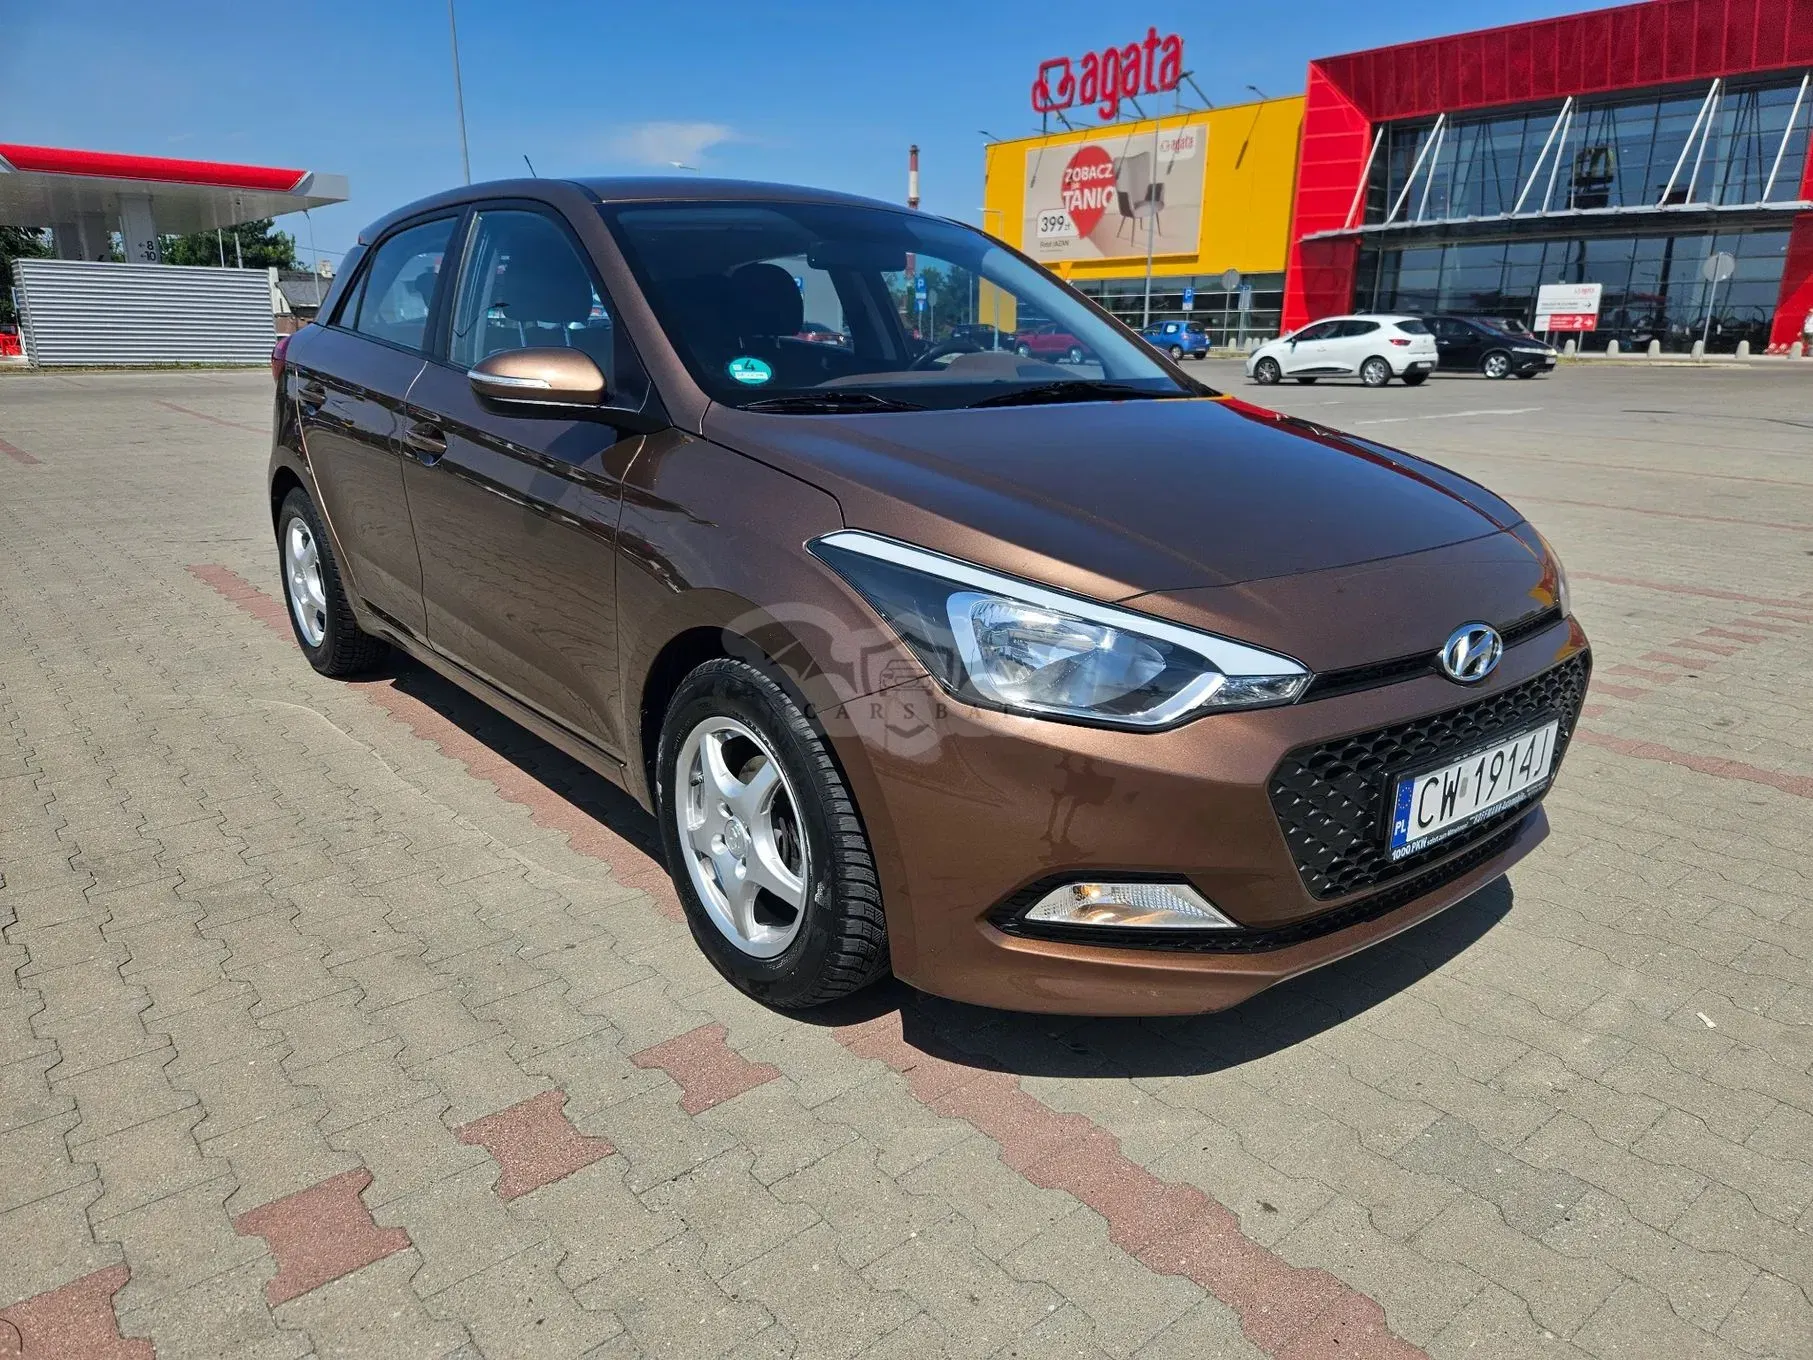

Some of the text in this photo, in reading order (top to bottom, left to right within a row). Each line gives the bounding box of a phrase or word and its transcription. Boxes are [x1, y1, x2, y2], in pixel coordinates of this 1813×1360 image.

[1079, 26, 1184, 120] agata
[1065, 163, 1114, 182] ZOBACZ
[1063, 186, 1117, 213] TANIO
[1041, 215, 1065, 233] 399
[147, 240, 154, 250] 8
[145, 251, 156, 261] 10
[1185, 289, 1192, 300] P
[1573, 316, 1583, 328] 2
[744, 359, 756, 371] 4
[1417, 766, 1462, 829] CW
[1475, 728, 1549, 807] 1914J
[1394, 819, 1407, 836] PL
[1392, 844, 1411, 861] 1000
[1411, 836, 1428, 853] PKW
